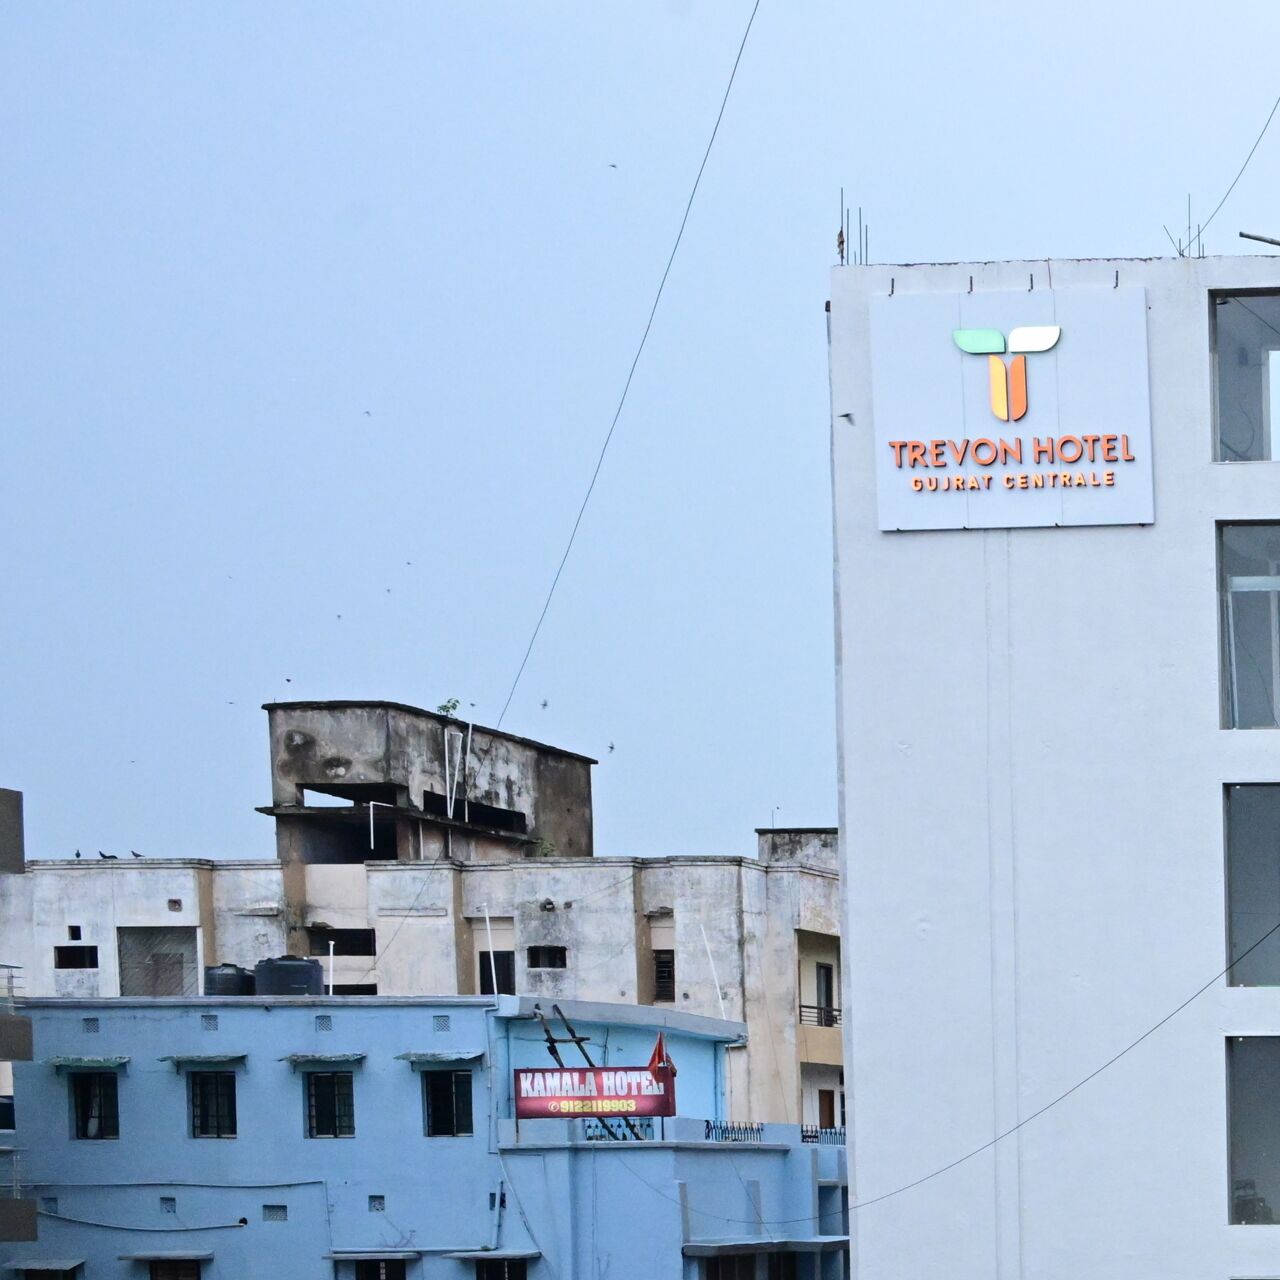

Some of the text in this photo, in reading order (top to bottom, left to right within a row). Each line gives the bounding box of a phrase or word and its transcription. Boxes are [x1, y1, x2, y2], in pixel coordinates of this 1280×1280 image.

[888, 434, 1135, 468] TREVON HOTEL
[911, 471, 1115, 491] GUJRAT CENTRALE
[520, 1072, 598, 1098] KAMALA
